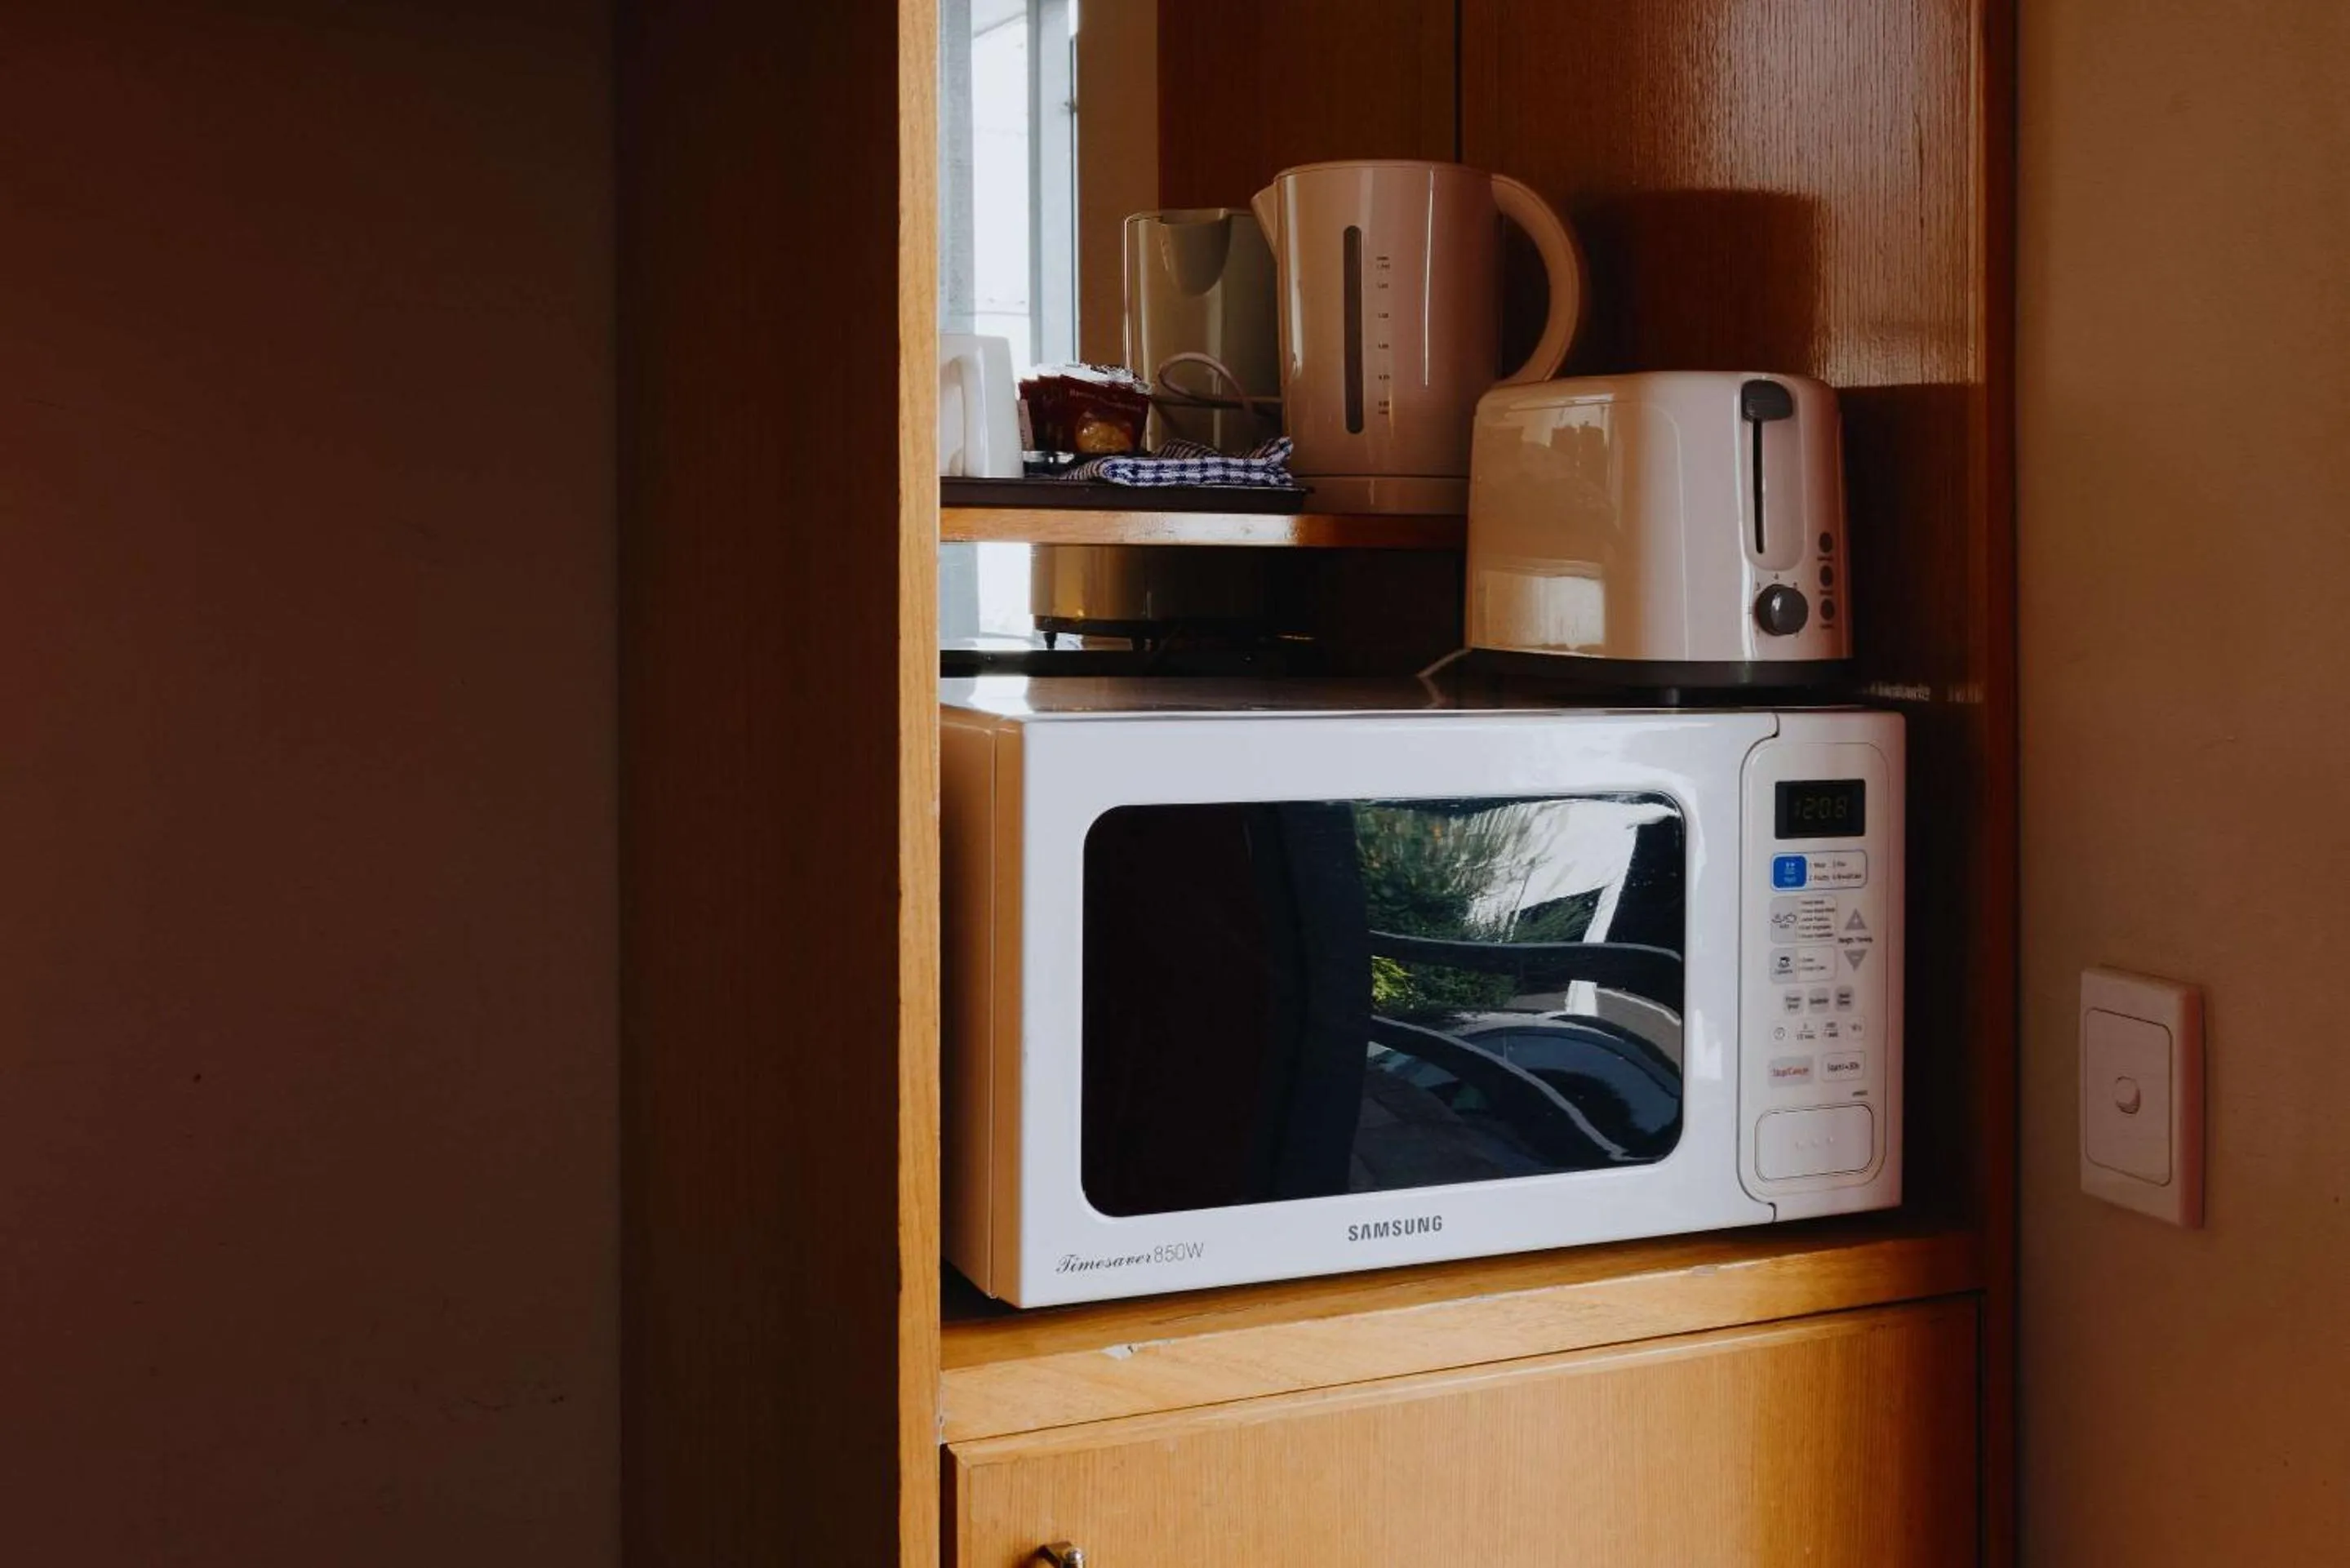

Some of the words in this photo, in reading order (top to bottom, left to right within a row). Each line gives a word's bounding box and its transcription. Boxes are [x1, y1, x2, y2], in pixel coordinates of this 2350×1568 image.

[1348, 1215, 1443, 1242] SAMSUNG
[1055, 1253, 1152, 1273] Timesaver
[1153, 1242, 1204, 1264] 850W
